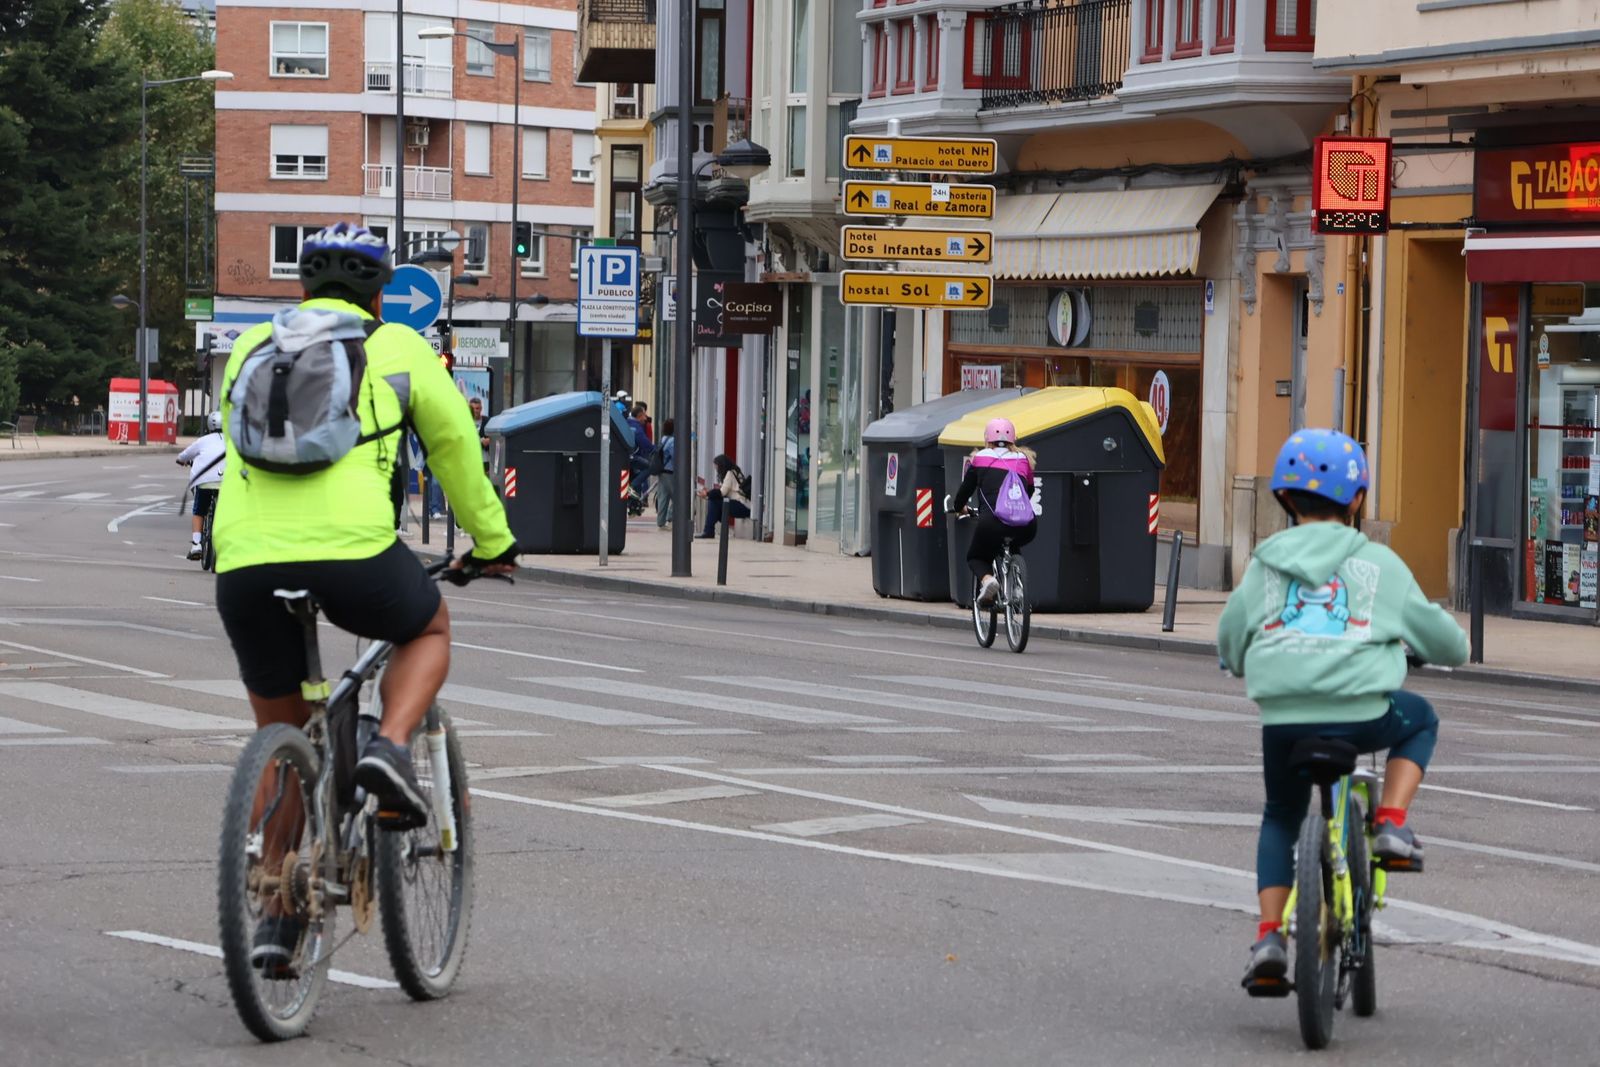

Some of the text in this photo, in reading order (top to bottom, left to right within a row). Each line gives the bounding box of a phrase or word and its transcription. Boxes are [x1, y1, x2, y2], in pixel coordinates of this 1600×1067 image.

[939, 146, 989, 156] hotel NH
[896, 157, 989, 168] Palacio del Duero
[1535, 157, 1600, 194] TABAC
[894, 199, 987, 213] Real de Zamora
[849, 232, 877, 241] hotel
[849, 243, 942, 256] Dos Infantas
[606, 257, 626, 283] P
[848, 283, 930, 296] hostal Sol
[458, 338, 497, 349] IBERDROLA
